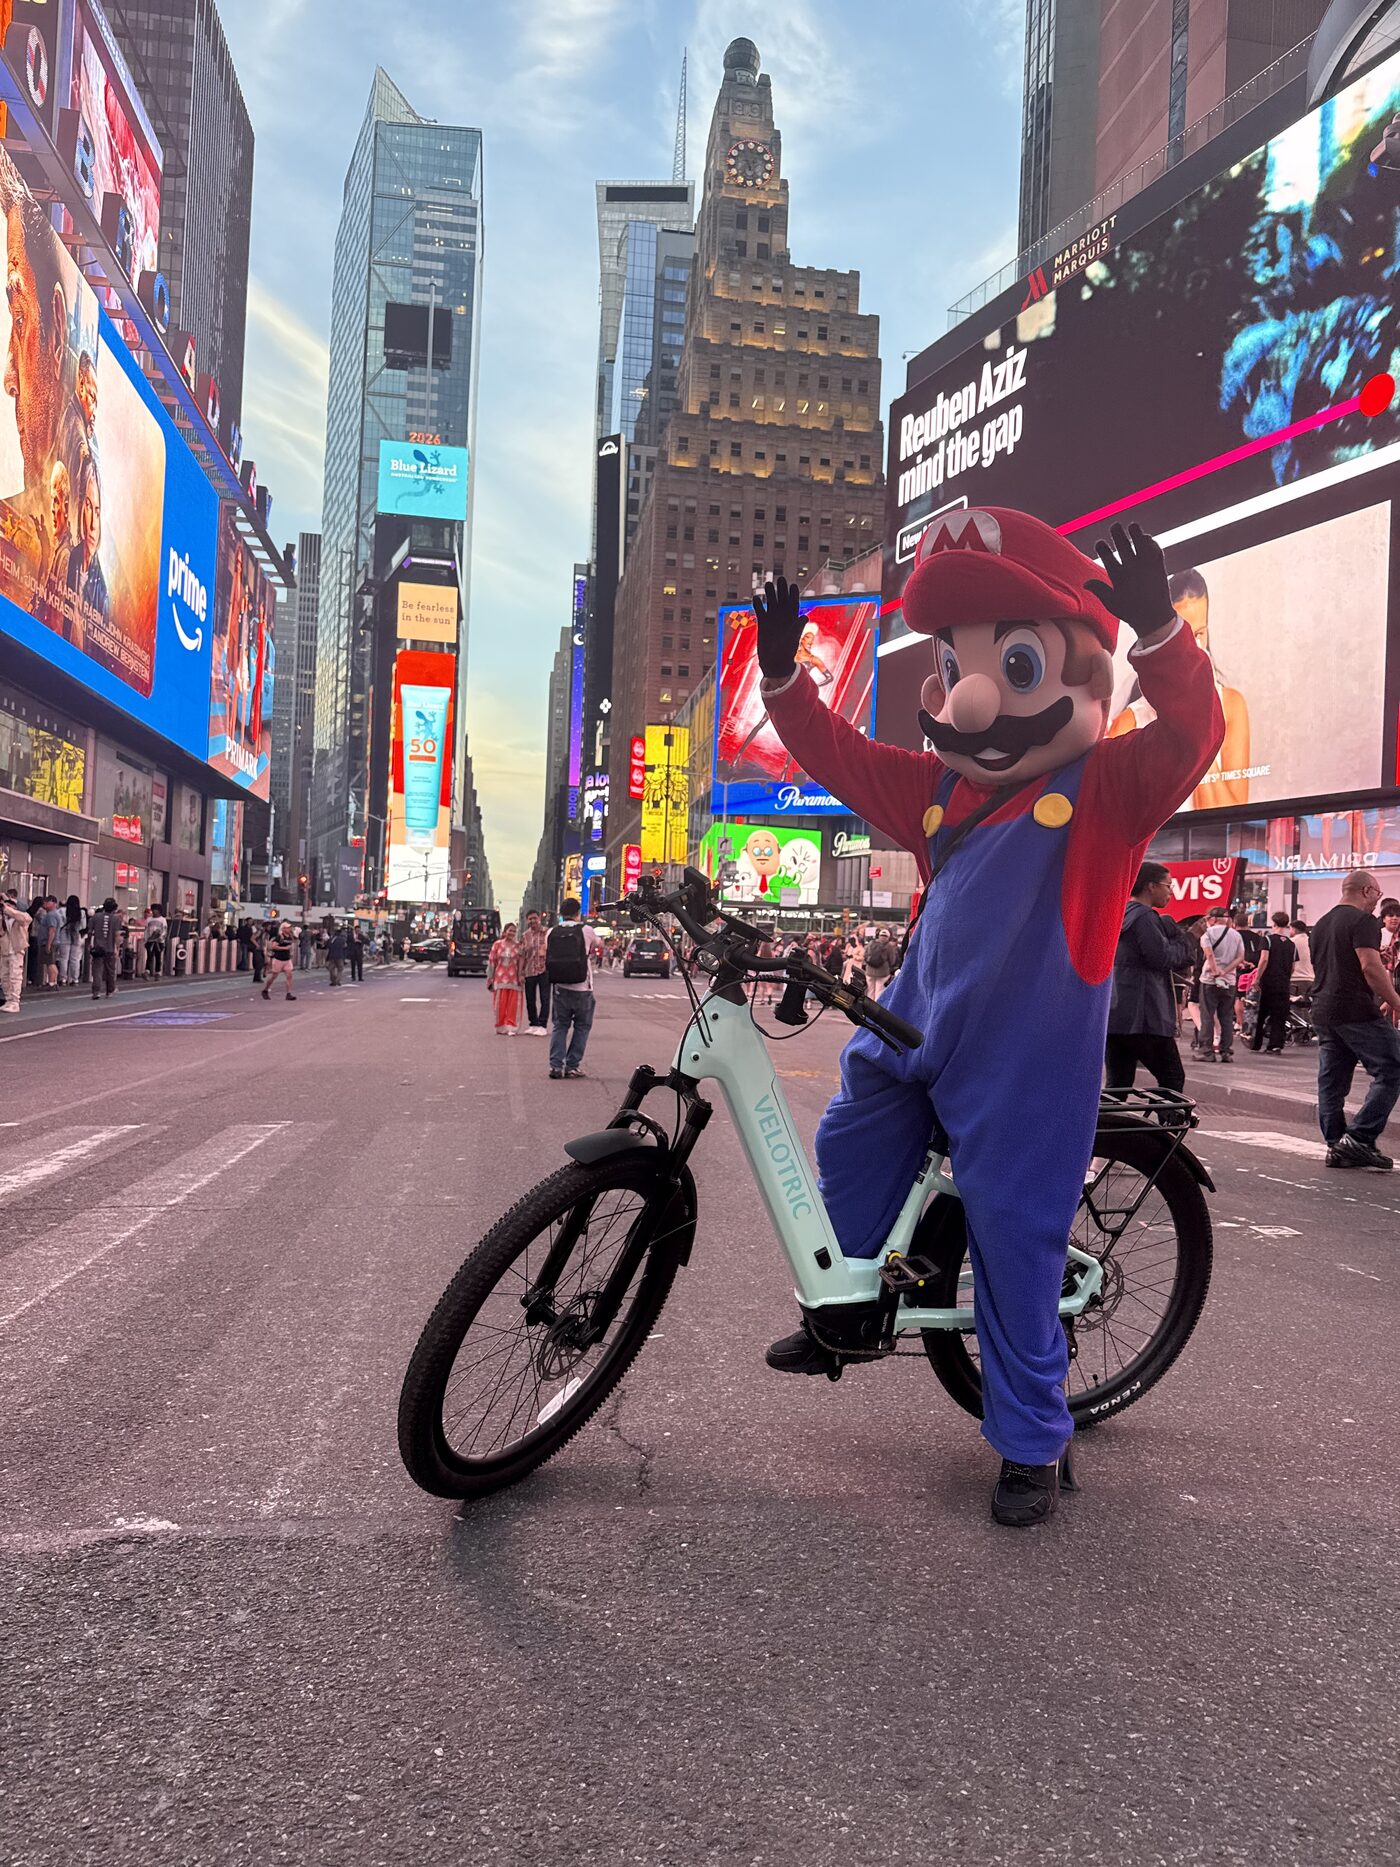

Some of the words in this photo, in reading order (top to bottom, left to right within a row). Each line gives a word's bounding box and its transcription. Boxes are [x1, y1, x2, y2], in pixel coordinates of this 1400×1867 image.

[1054, 214, 1117, 269] MARRIOTT
[1053, 238, 1109, 284] MARQUIS
[900, 381, 977, 461] Reuben
[977, 345, 1028, 414] Aziz
[409, 432, 441, 445] 2026
[391, 459, 418, 473] Blue
[420, 462, 457, 476] Lizard
[896, 440, 946, 507] mind
[946, 430, 981, 479] the
[981, 404, 1023, 468] gap
[168, 546, 207, 622] prime
[401, 600, 414, 610] Be
[416, 600, 455, 613] fearless
[401, 612, 412, 622] in
[415, 613, 430, 623] the
[433, 617, 451, 625] sun
[225, 736, 258, 781] PRIMARK
[410, 738, 436, 754] 50
[1221, 770, 1241, 781] TIMES
[1242, 765, 1271, 779] SQUARE
[1170, 874, 1223, 900] VI'S
[754, 1094, 812, 1220] VELOTRIC
[1089, 1381, 1142, 1414] KENDA
